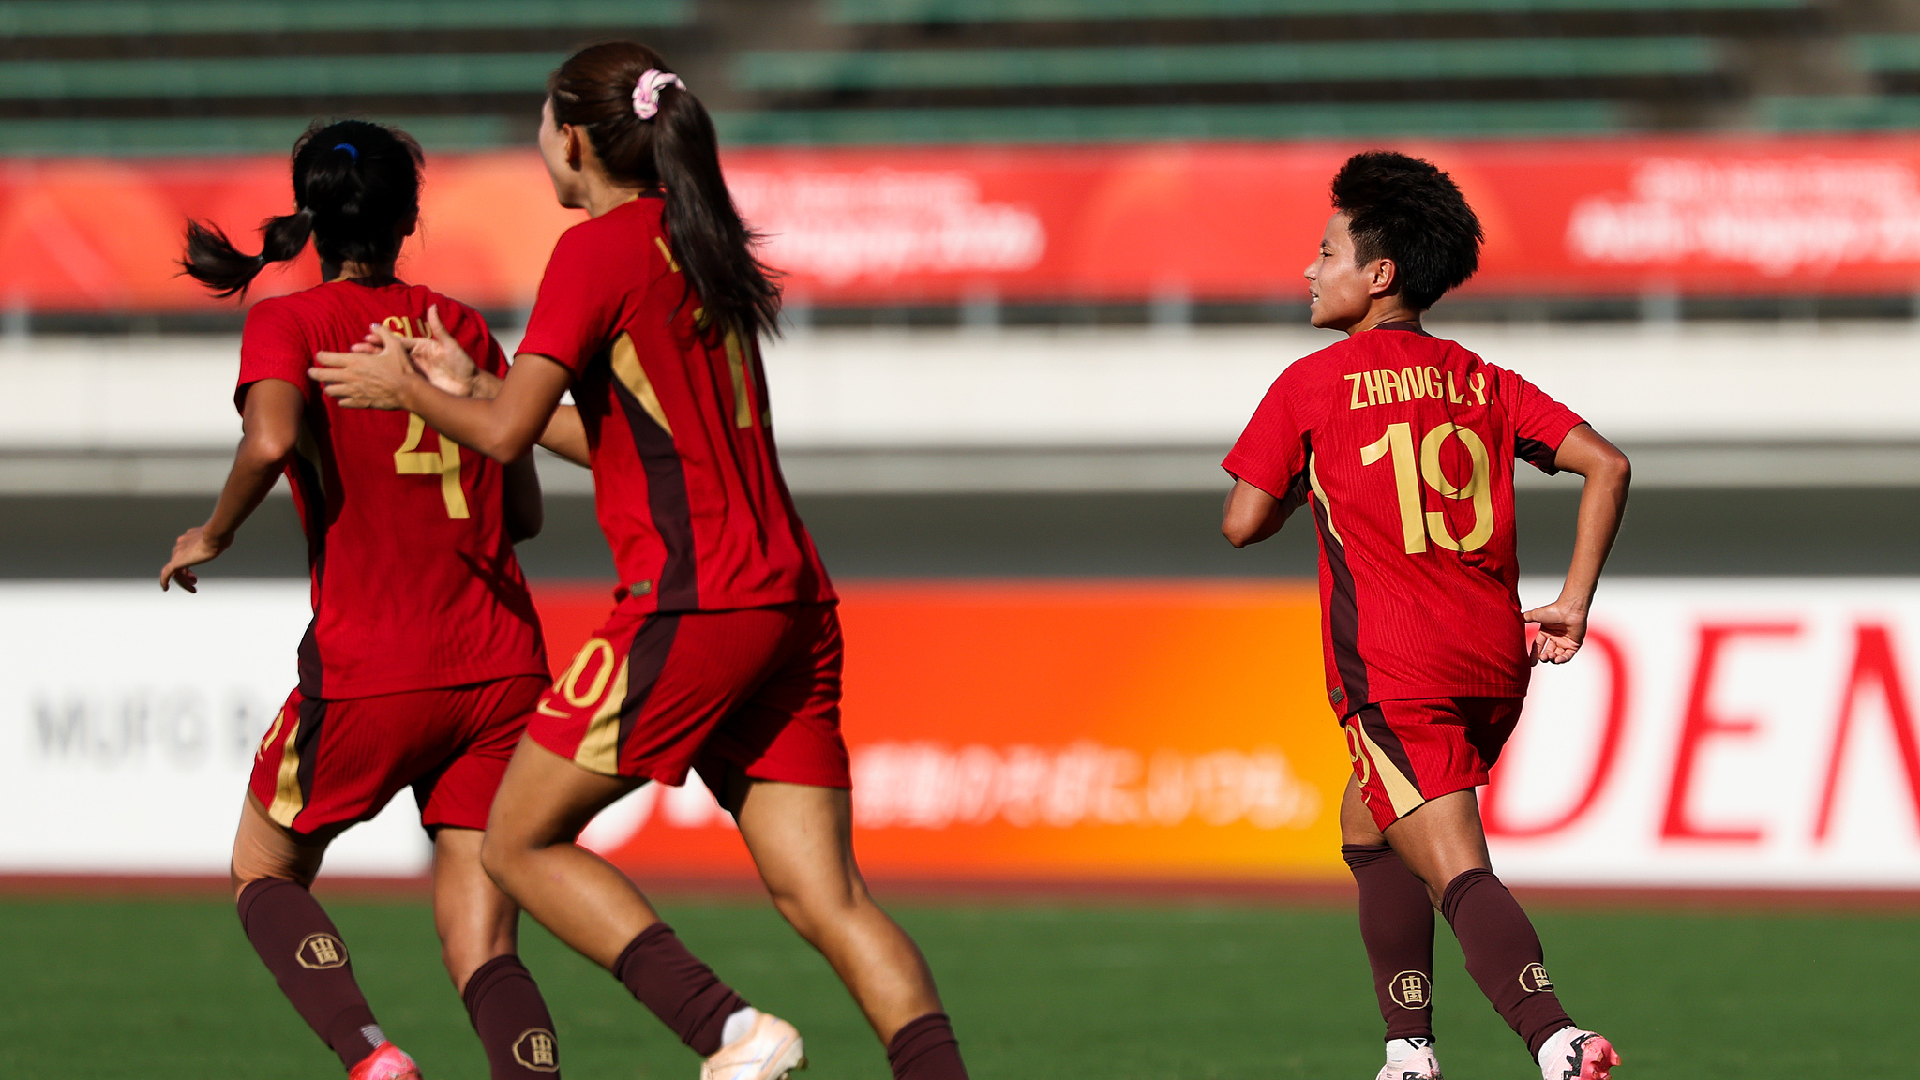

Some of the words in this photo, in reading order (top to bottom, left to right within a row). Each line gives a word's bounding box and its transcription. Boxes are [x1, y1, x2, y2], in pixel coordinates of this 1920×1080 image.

[1344, 366, 1444, 410] ZHANG
[393, 411, 471, 519] 4
[1360, 421, 1494, 554] 19
